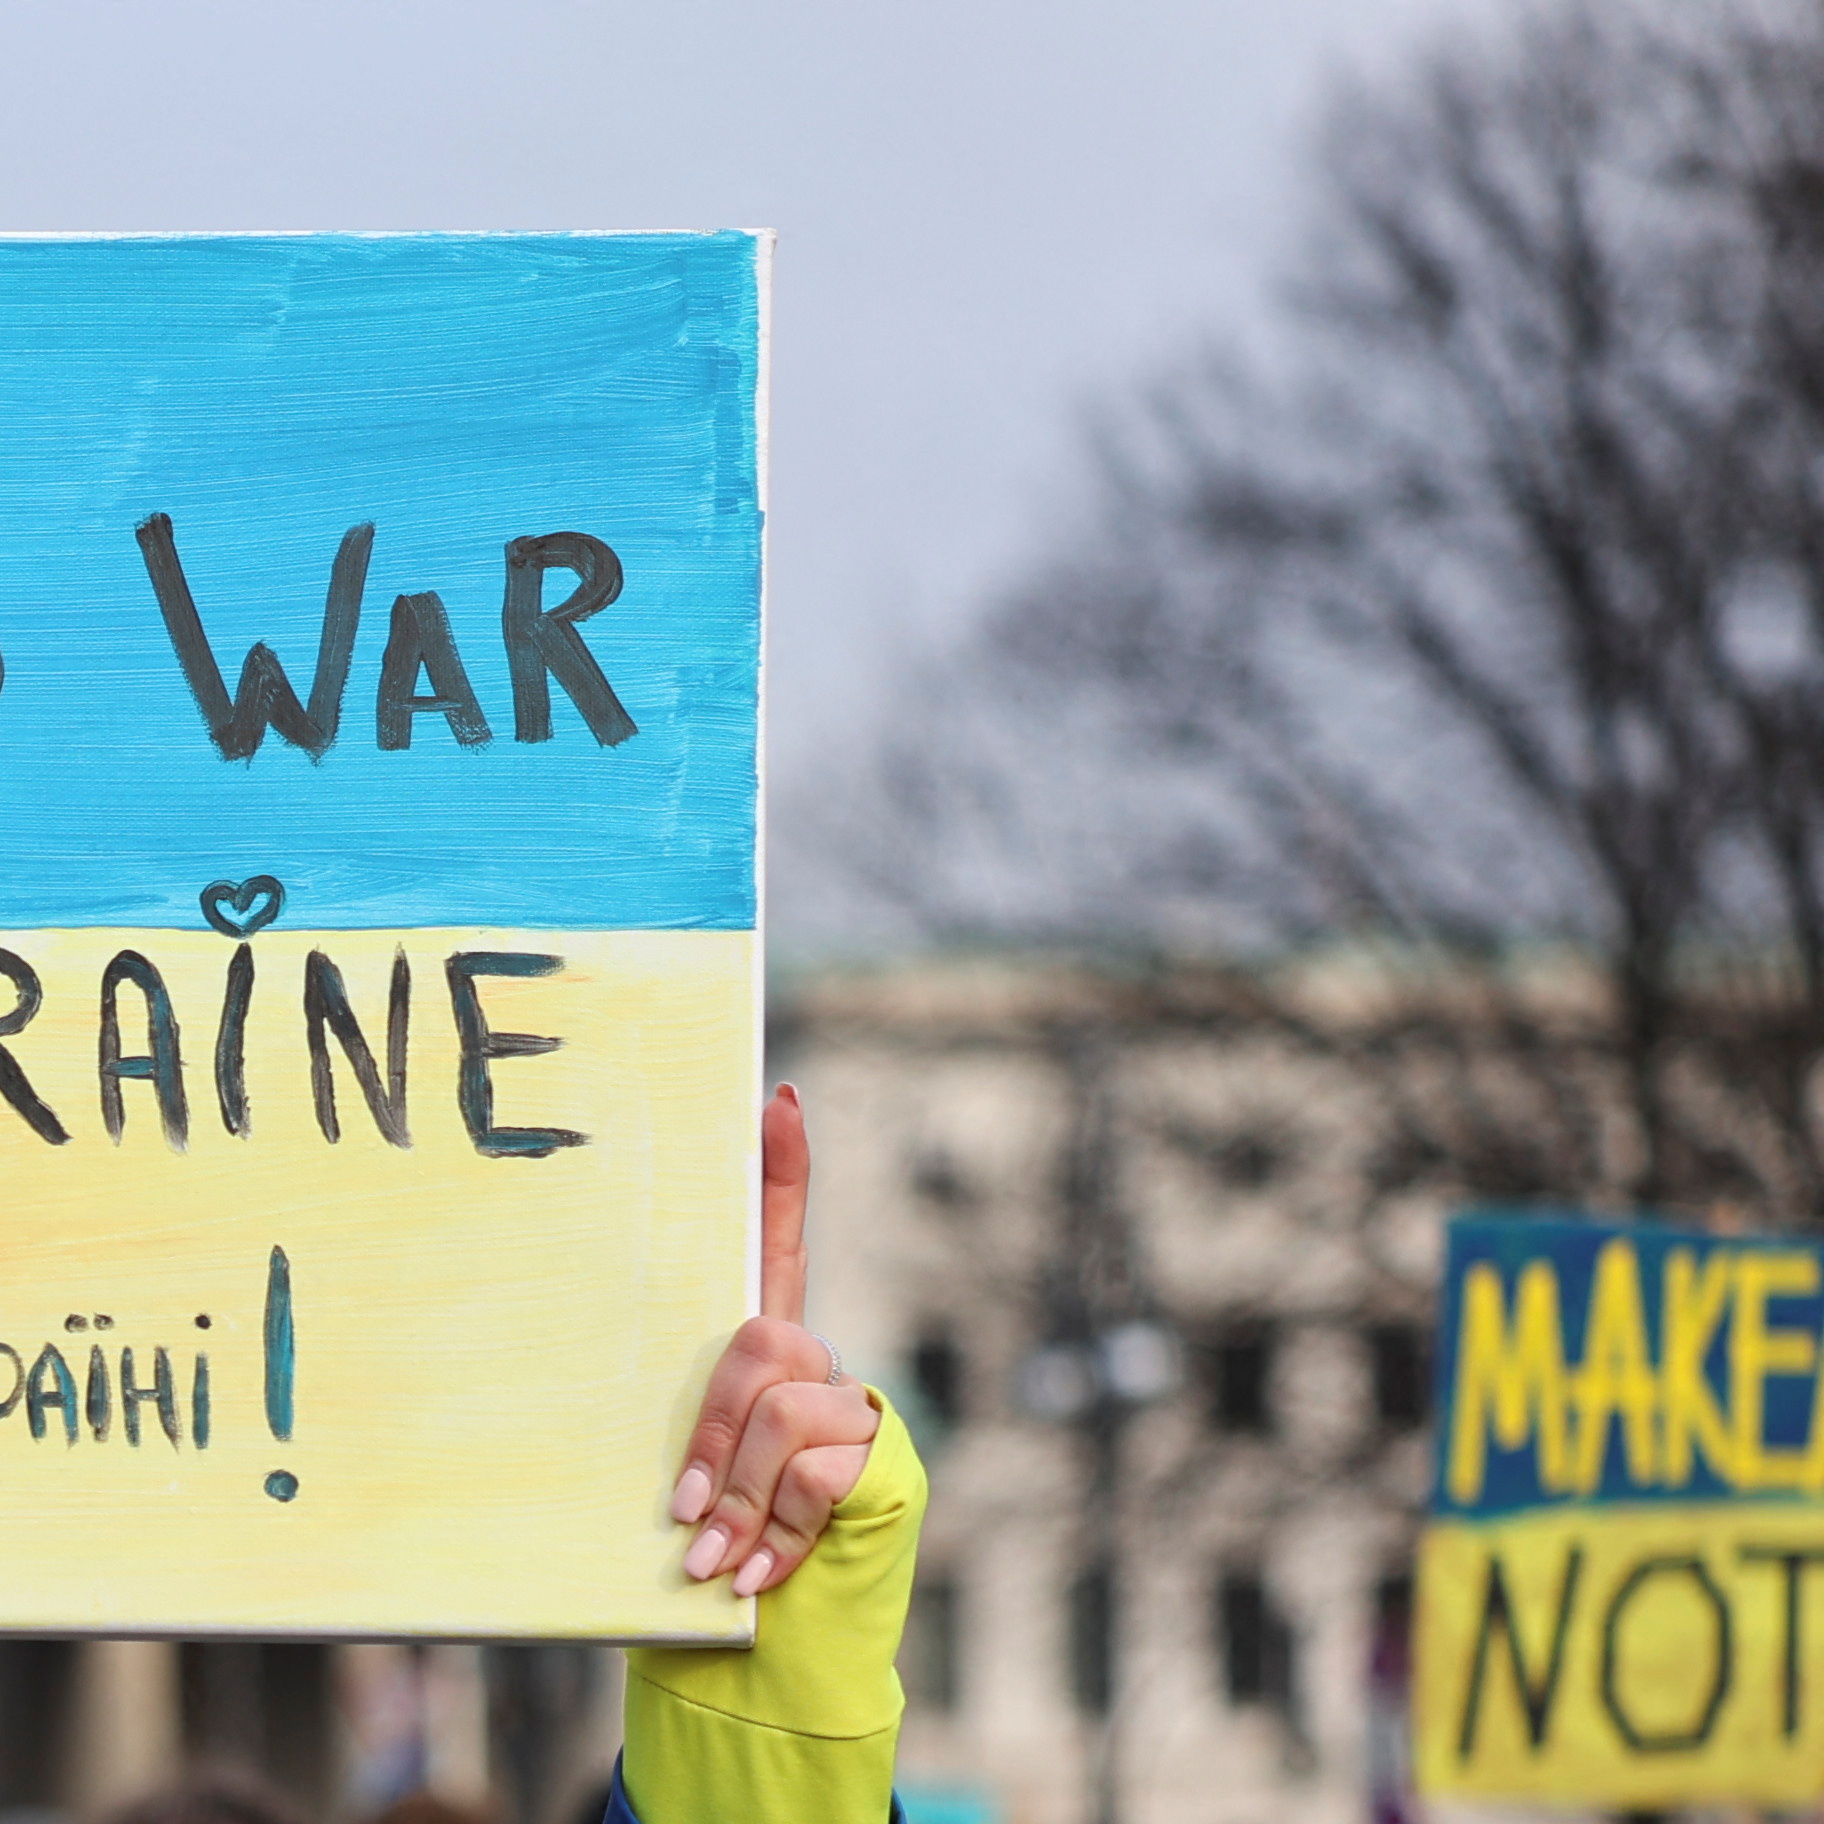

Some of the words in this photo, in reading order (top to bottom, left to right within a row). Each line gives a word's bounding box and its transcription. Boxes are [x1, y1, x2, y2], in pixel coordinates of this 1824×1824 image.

[135, 512, 639, 764] WAR
[1450, 1240, 1824, 1502] MAKE
[1456, 1544, 1824, 1763] NOT
